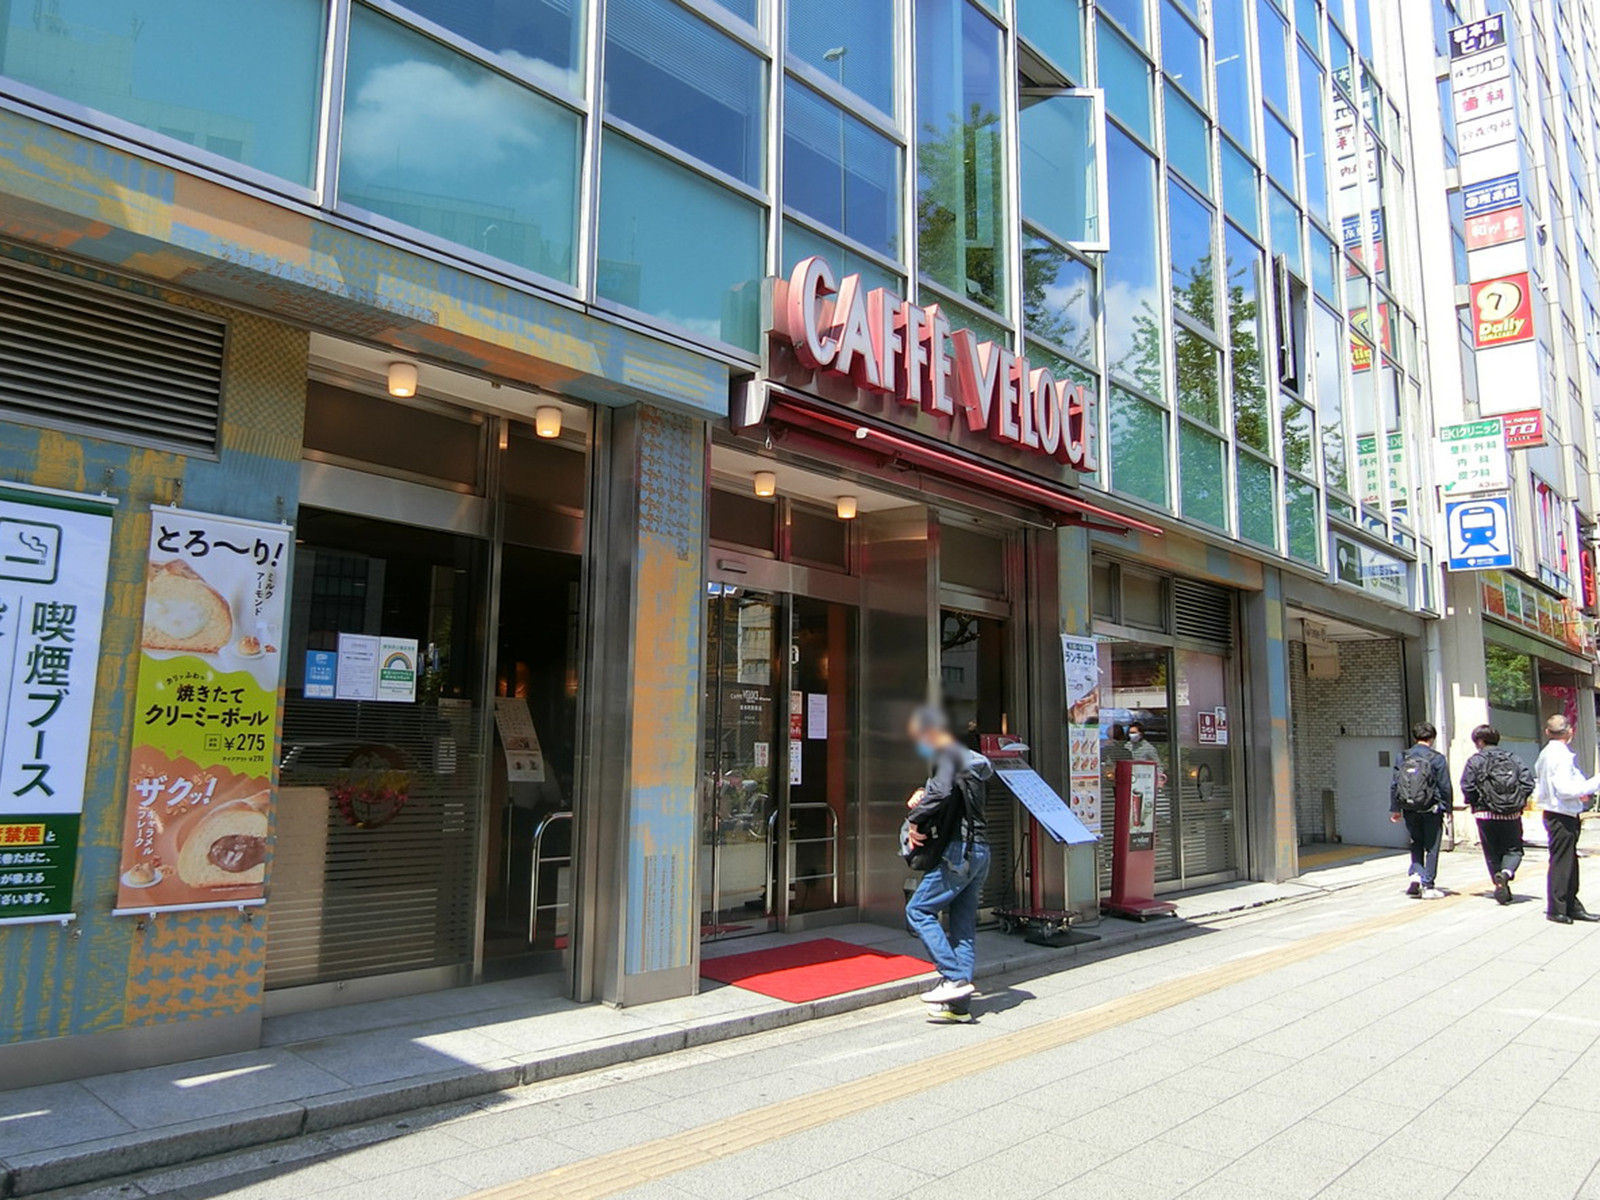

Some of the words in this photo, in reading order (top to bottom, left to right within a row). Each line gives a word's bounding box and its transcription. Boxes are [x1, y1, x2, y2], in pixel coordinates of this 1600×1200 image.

[1461, 33, 1495, 54] ビル
[1479, 317, 1526, 337] Daily
[952, 327, 1099, 474] VELOCE
[1441, 422, 1500, 440] EKIクリニック
[254, 572, 265, 616] アーモンド
[265, 573, 275, 600] ミルク
[12, 601, 78, 798] 喫煙ブース
[176, 683, 246, 704] 焼きたて
[145, 704, 270, 728] クリーミーボール
[223, 733, 266, 752] ¥275
[0, 826, 57, 844] 禁煙と
[135, 810, 146, 848] フレーク
[143, 810, 155, 856] キャラメル
[0, 892, 50, 906] ざいます。
